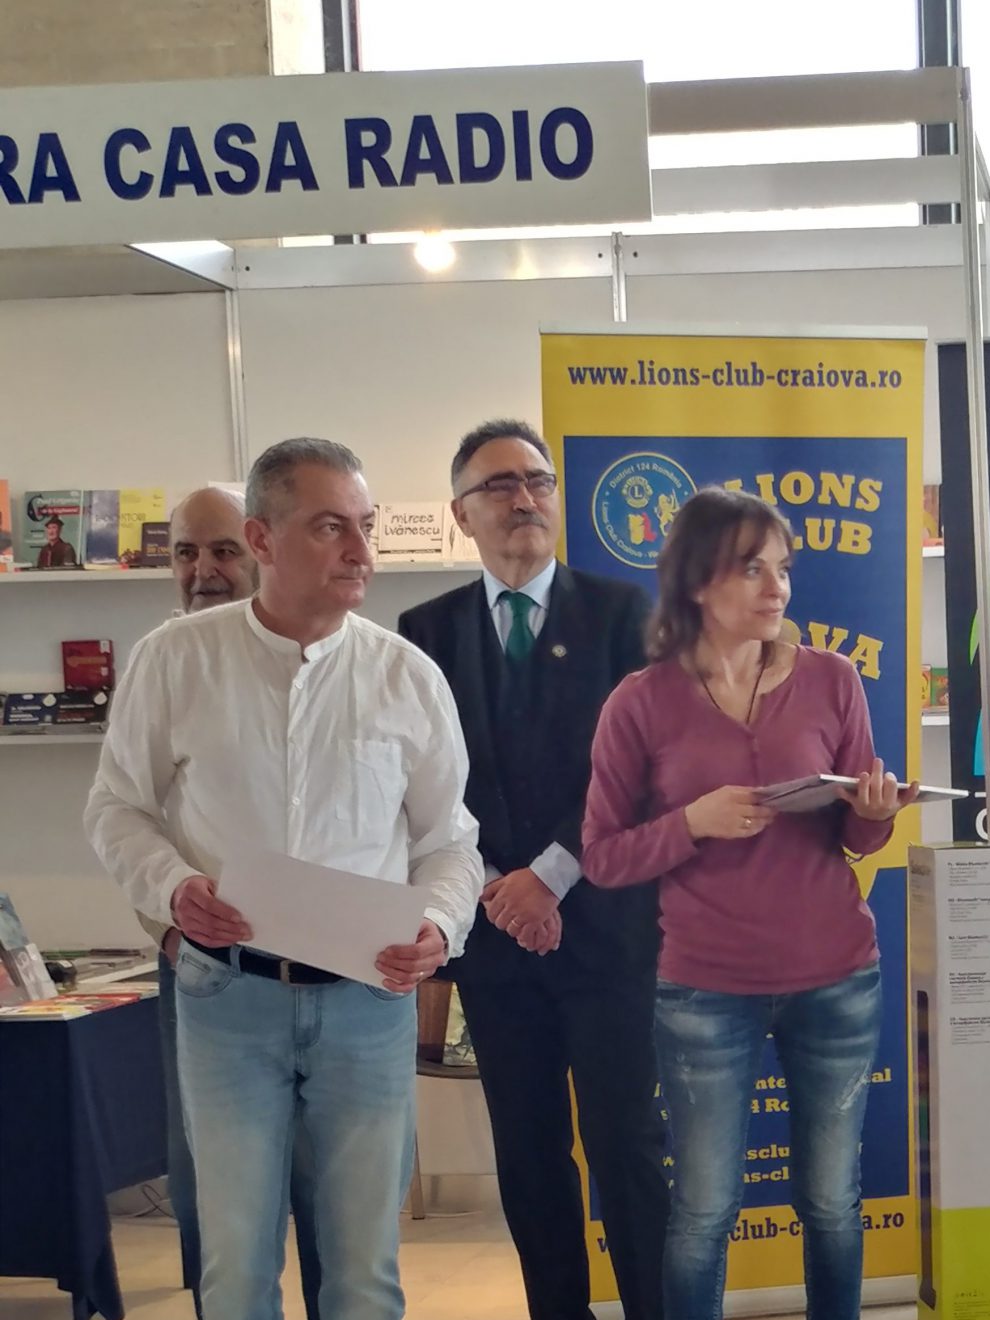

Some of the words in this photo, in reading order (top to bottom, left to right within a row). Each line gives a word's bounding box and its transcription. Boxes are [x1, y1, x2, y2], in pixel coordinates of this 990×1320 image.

[104, 121, 320, 200] CASA
[344, 107, 594, 189] RADIO
[568, 360, 902, 389] www.lions-club-craiova.ro
[636, 462, 650, 471] 124
[724, 470, 883, 513] IONS
